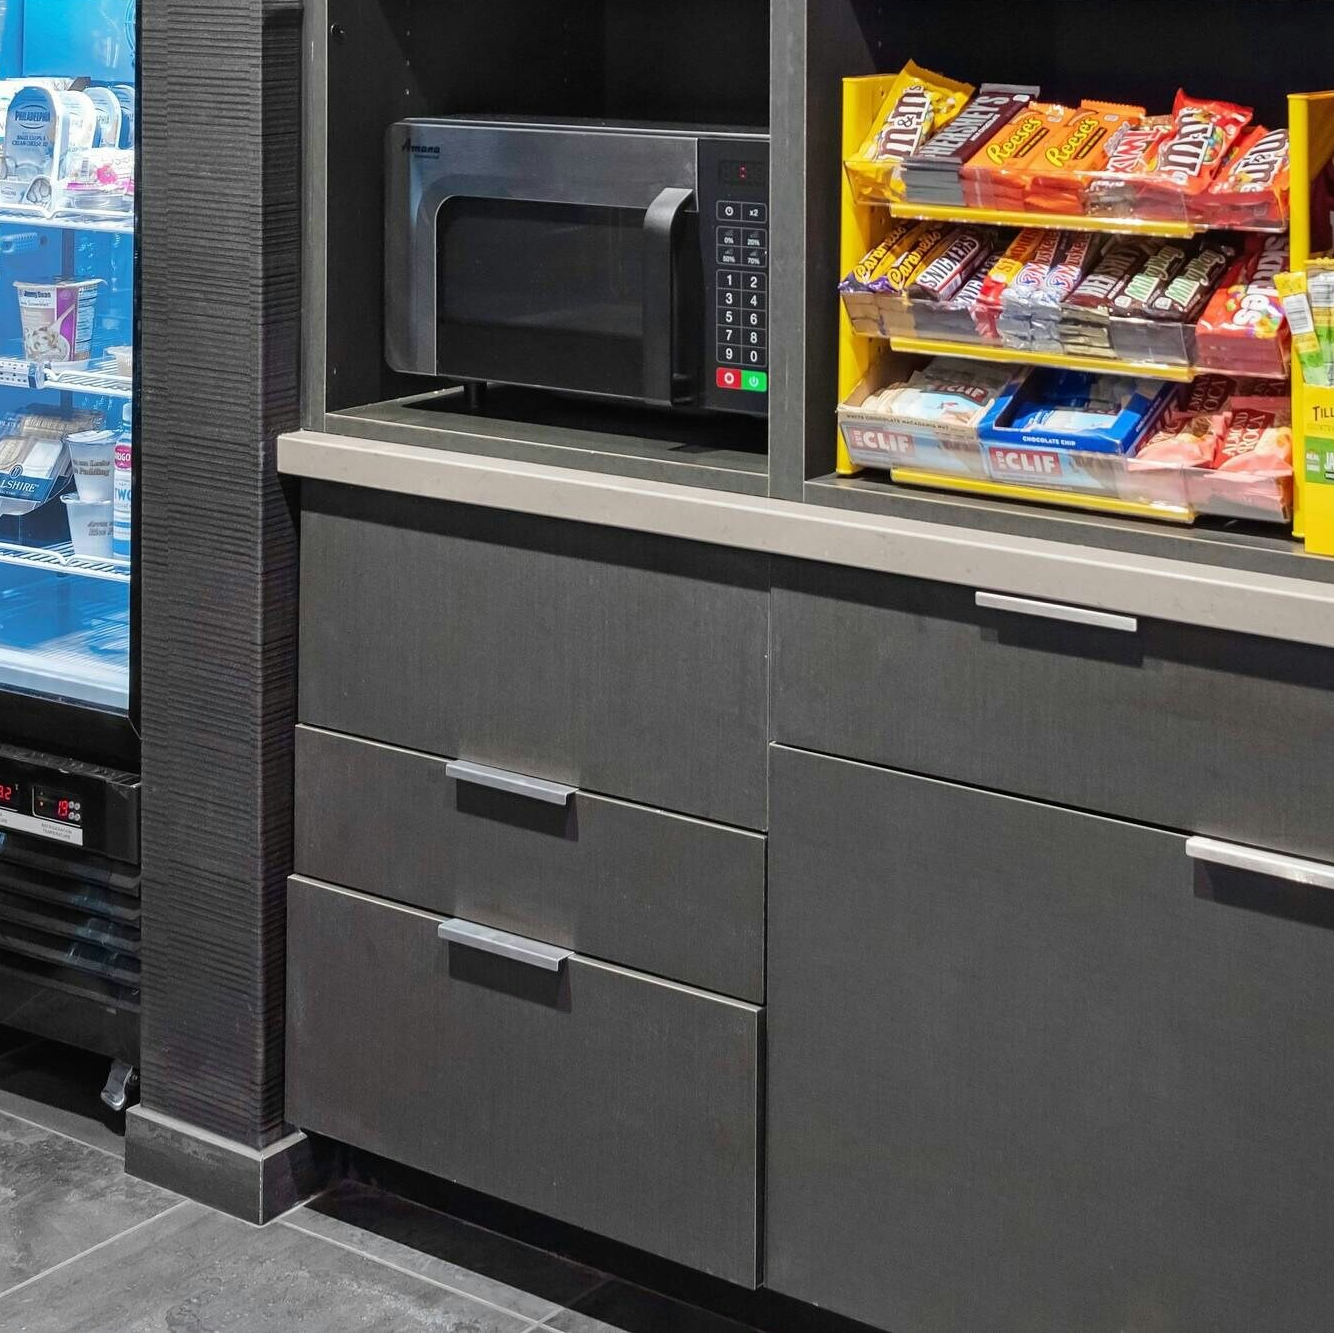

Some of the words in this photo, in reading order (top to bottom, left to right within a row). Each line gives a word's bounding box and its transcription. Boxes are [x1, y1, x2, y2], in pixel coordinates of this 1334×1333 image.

[986, 116, 1043, 166] Reese's
[1045, 117, 1099, 168] Reese's
[749, 209, 759, 217] x2
[918, 234, 979, 288] SNICKERS
[727, 274, 733, 286] 1
[750, 276, 758, 288] 2
[725, 292, 733, 305] 3
[750, 295, 758, 307] 4
[725, 310, 733, 323] 5
[750, 313, 758, 325] 6
[725, 329, 733, 341] 7
[750, 332, 758, 344] 8
[725, 348, 733, 360] 9
[750, 350, 758, 363] 0
[863, 431, 910, 453] CLIF
[1022, 435, 1061, 446] CHOCOLATE
[1061, 439, 1077, 447] CHIP
[1004, 451, 1056, 473] CLIF
